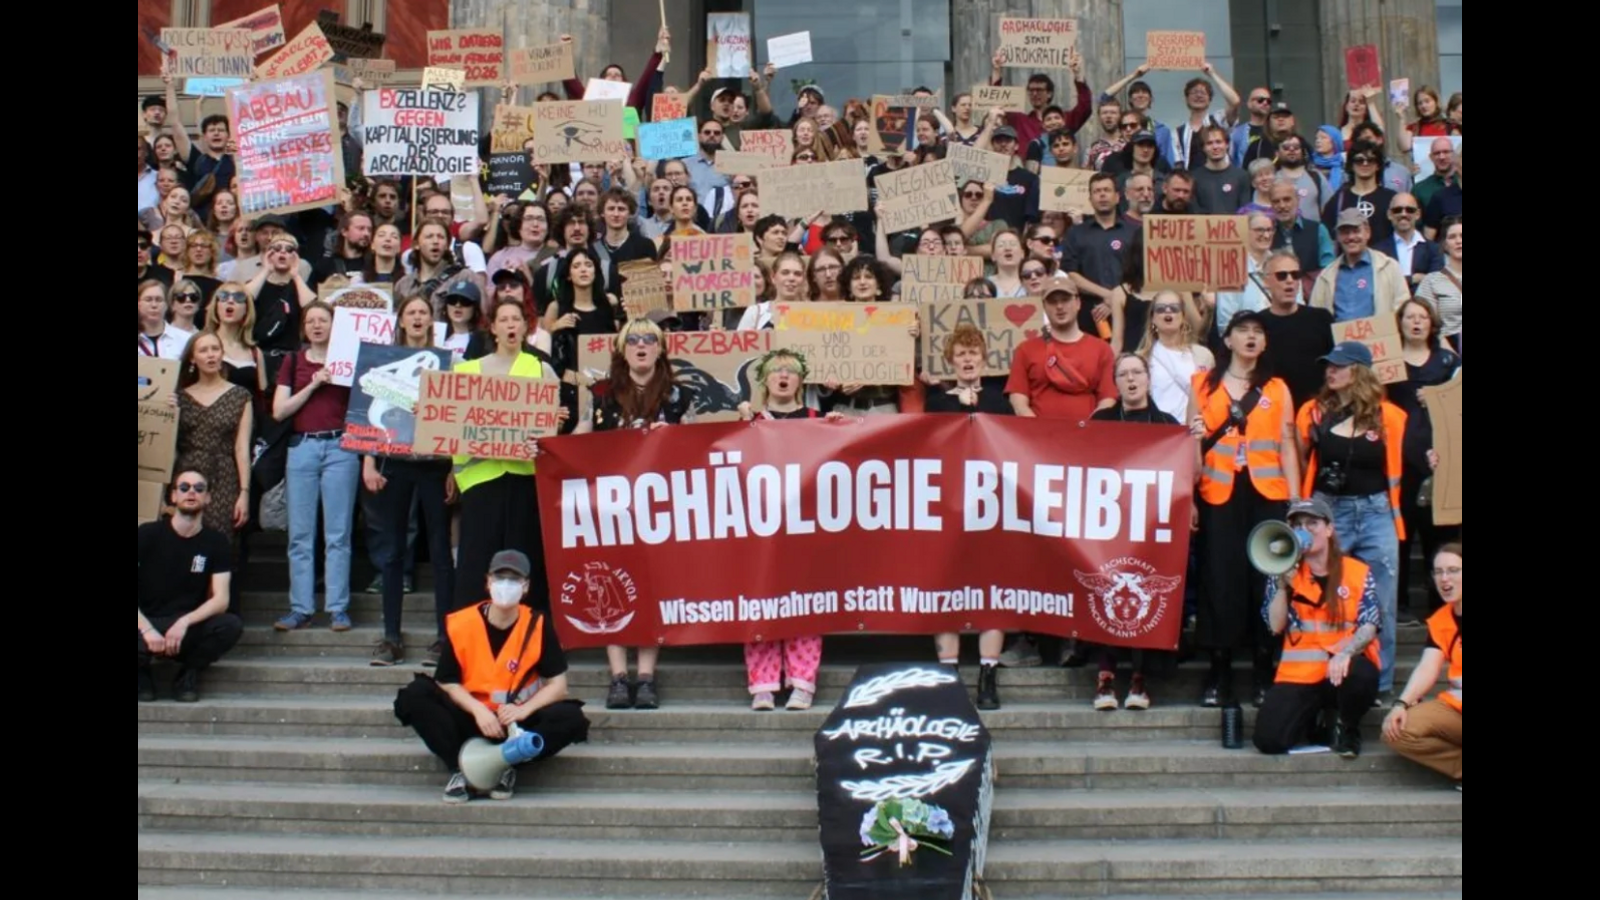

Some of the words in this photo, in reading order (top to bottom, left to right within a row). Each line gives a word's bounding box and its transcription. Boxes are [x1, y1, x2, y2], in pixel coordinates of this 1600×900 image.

[1024, 35, 1051, 45] STATT
[1157, 46, 1189, 56] STATT
[464, 65, 499, 80] 2026
[238, 87, 315, 123] ABBAU
[379, 88, 467, 112] EXZELLENZ?
[979, 89, 1012, 100] NEIN
[394, 110, 445, 128] GEGEN
[537, 105, 575, 120] KEINE
[364, 125, 478, 147] KAPITALISIERUNG
[742, 131, 785, 147] WHO'S
[407, 143, 439, 159] DER
[537, 144, 574, 159] OHNE
[876, 160, 955, 199] WEGNER
[883, 193, 958, 229] FAUSTKEIL!
[1149, 219, 1195, 241] HEUTE
[1206, 219, 1240, 240] WIR
[673, 236, 735, 261] HEUTE
[682, 259, 735, 275] WIR
[903, 255, 946, 283] ALFA
[1147, 245, 1211, 284] MORGEN
[1217, 246, 1246, 285] IHR!
[676, 271, 753, 294] MORGEN
[692, 291, 737, 309] IHR
[349, 312, 395, 338] TRA
[822, 331, 850, 345] UND
[824, 345, 853, 359] TOD
[862, 344, 888, 358] DER
[807, 361, 911, 382] HÄOLOGIE!
[427, 373, 521, 401] NIEMAND
[526, 382, 558, 405] HAT
[423, 404, 457, 423] DIE
[462, 406, 533, 427] ABSICHT
[535, 411, 557, 427] EIN
[432, 436, 459, 455] ZU
[561, 450, 942, 549] ARCHÄOLOGIE
[963, 459, 1175, 543] BLEIBT!
[1099, 556, 1157, 575] FACHSCHAFT
[559, 571, 583, 606] FSI
[611, 566, 639, 604] AKNOA
[659, 598, 735, 626] Wissen
[737, 590, 839, 623] bewahren
[843, 585, 895, 613] statt
[899, 585, 985, 614] Wurzeln
[989, 584, 1075, 618] kappen!
[822, 707, 980, 742] ARCHÄOLOGIE
[854, 742, 952, 770] R.I.P.
